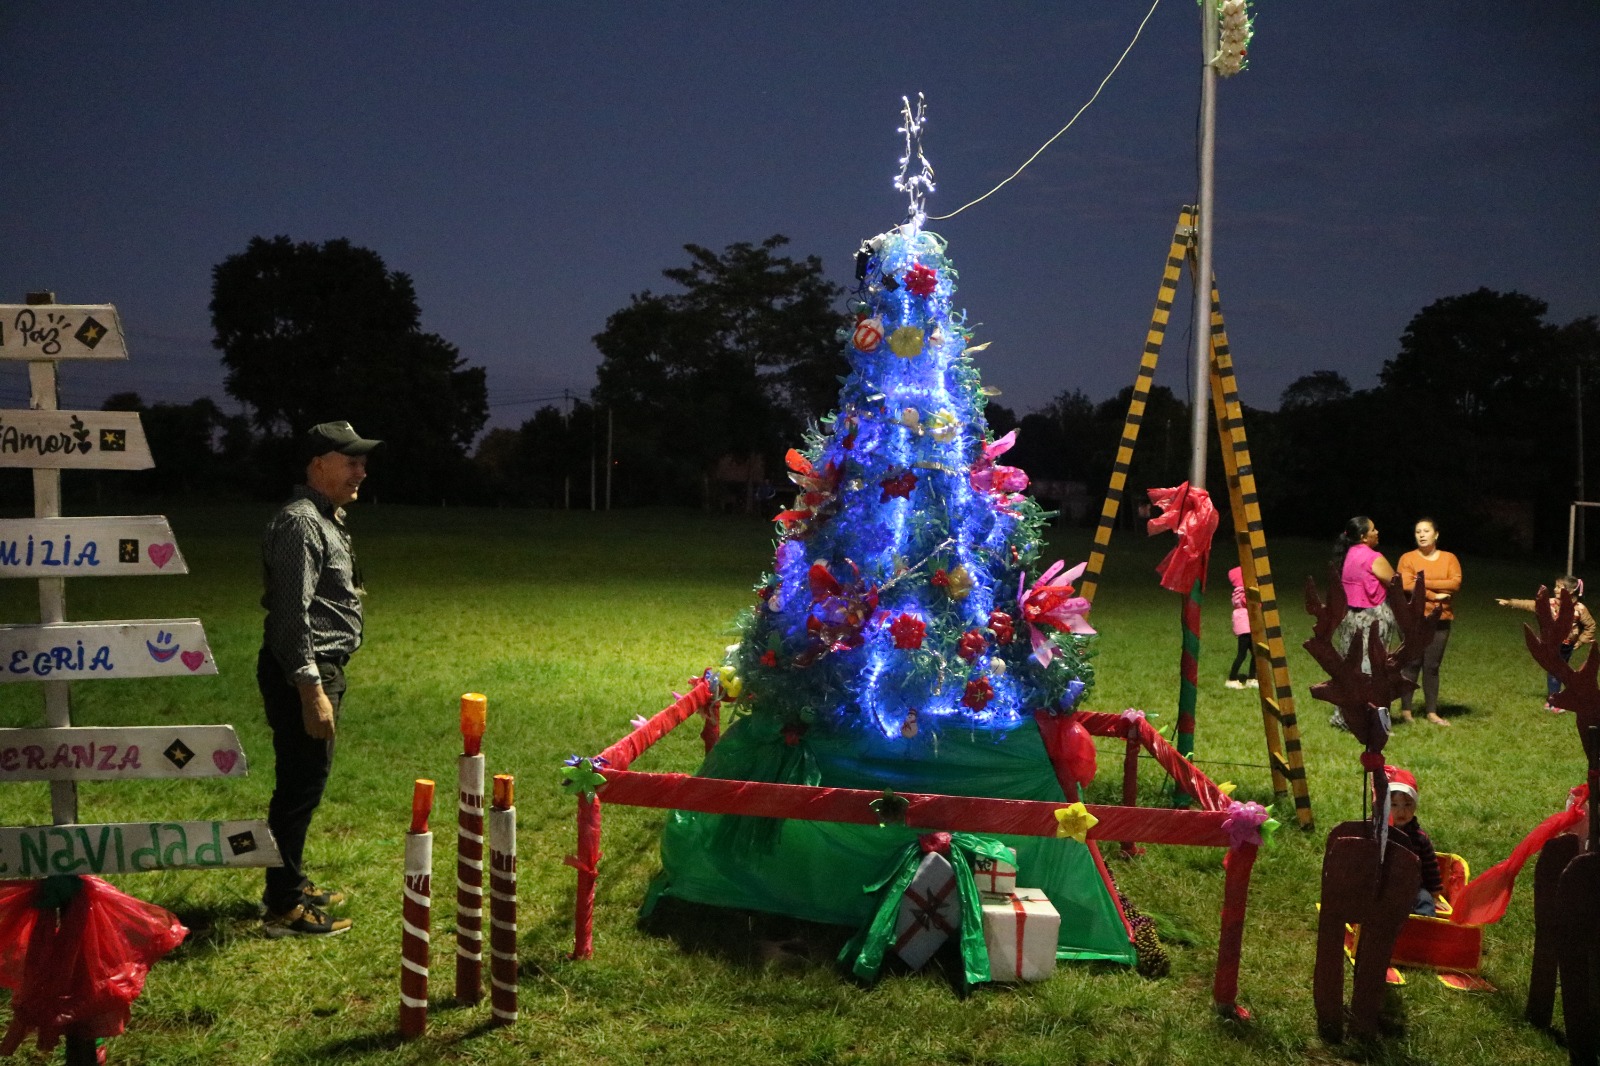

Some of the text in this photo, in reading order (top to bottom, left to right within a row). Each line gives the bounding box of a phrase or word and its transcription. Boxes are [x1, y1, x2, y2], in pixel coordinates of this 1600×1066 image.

[15, 309, 62, 355] Paz
[2, 426, 76, 455] Amor
[0, 640, 114, 676] EGRIA
[0, 741, 142, 771] ERANZA
